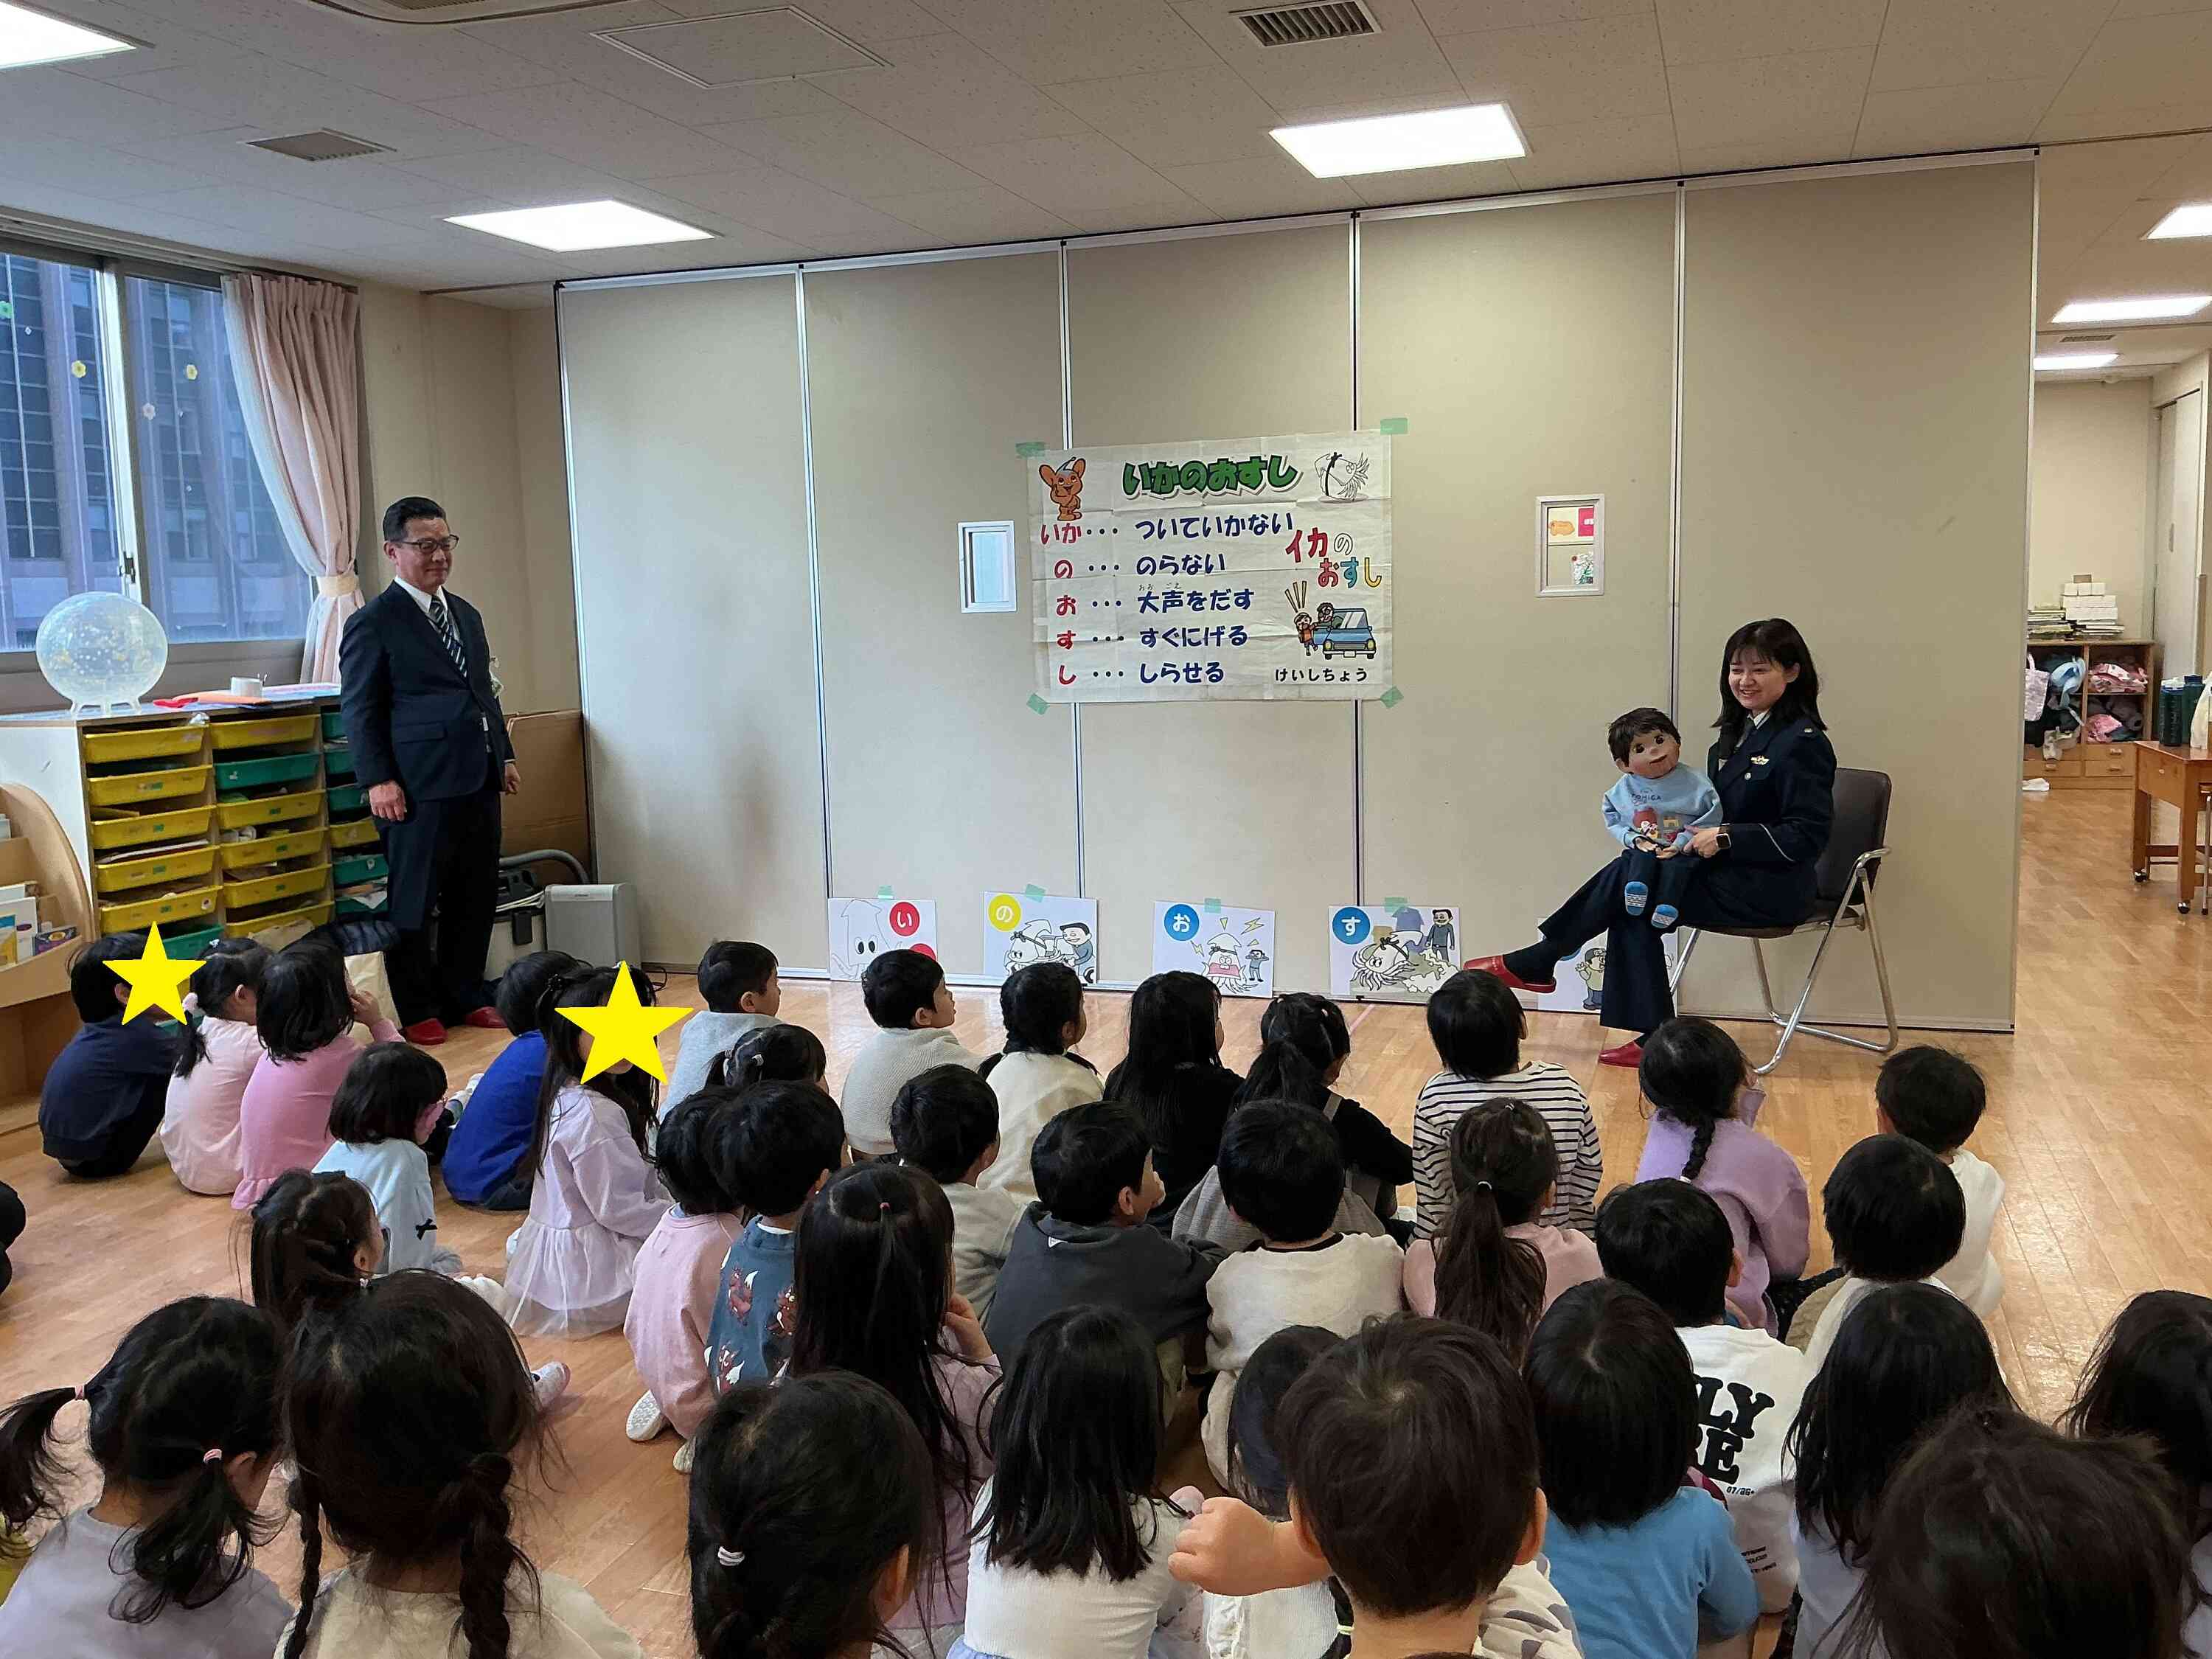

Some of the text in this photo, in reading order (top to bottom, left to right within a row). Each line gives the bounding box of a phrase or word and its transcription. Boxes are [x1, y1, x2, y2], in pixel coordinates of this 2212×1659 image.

[1122, 455, 1297, 495] いかのおすし
[1041, 523, 1082, 544] いか
[1135, 513, 1293, 540] ついていかない
[1285, 527, 1353, 563] イカの
[1054, 560, 1073, 578] の
[1136, 554, 1225, 576] のらない
[1318, 557, 1382, 588] おすし
[1057, 595, 1077, 616] お
[1138, 588, 1254, 613] 大声をだす
[1057, 630, 1077, 650] す
[1140, 626, 1248, 647] すぐにげる
[1059, 665, 1077, 685] し
[1140, 662, 1224, 684] しらせる
[1276, 667, 1368, 682] けいしちょう
[897, 911, 913, 928] い
[996, 905, 1013, 923] の
[1172, 913, 1190, 933] お
[1341, 917, 1360, 936] す
[1693, 1374, 1775, 1439] LY
[1696, 1427, 1743, 1485] E
